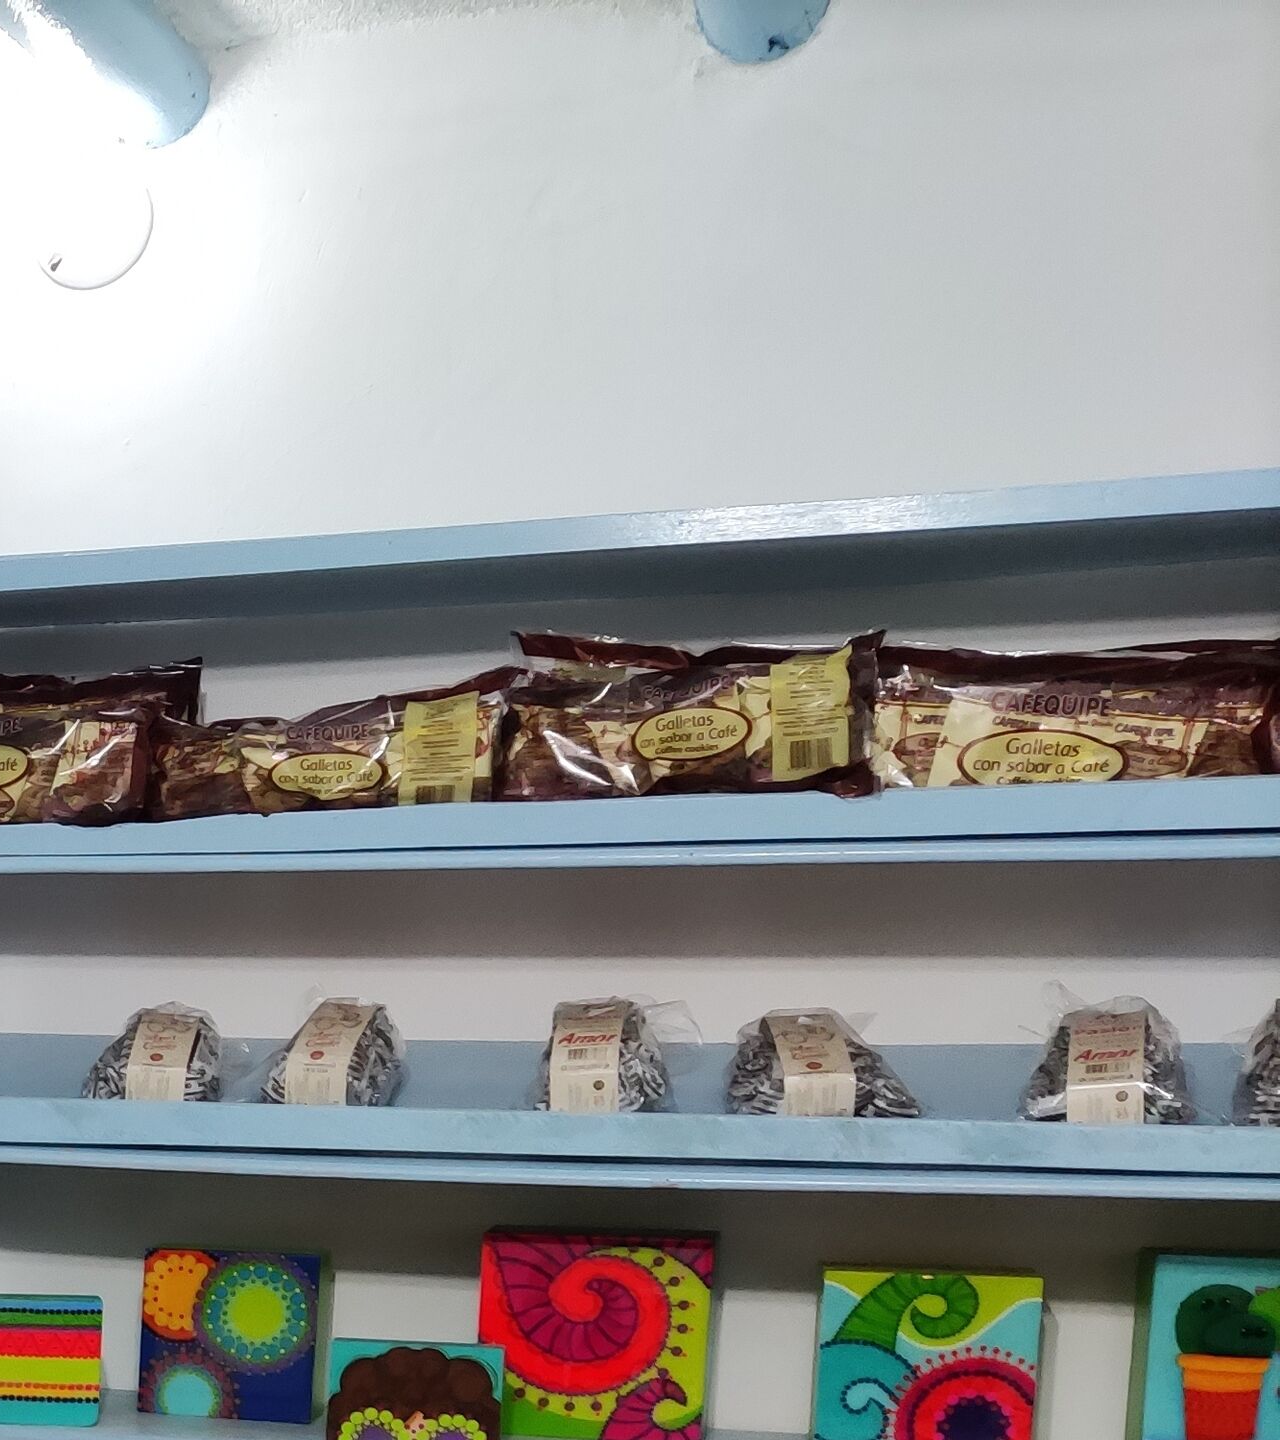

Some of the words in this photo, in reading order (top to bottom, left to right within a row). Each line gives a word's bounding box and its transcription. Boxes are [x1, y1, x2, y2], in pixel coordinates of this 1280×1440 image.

[991, 692, 1112, 717] CAFEQUIPE
[286, 723, 370, 741] CAFEQUIPE
[656, 715, 714, 732] Galletas
[658, 732, 692, 745] sabor
[708, 725, 738, 740] Café
[1005, 738, 1081, 757] Galletas
[300, 758, 353, 772] Galletas
[973, 759, 1001, 771] con
[1006, 756, 1050, 773] sabor
[1055, 763, 1065, 774] a
[302, 773, 333, 785] sabor
